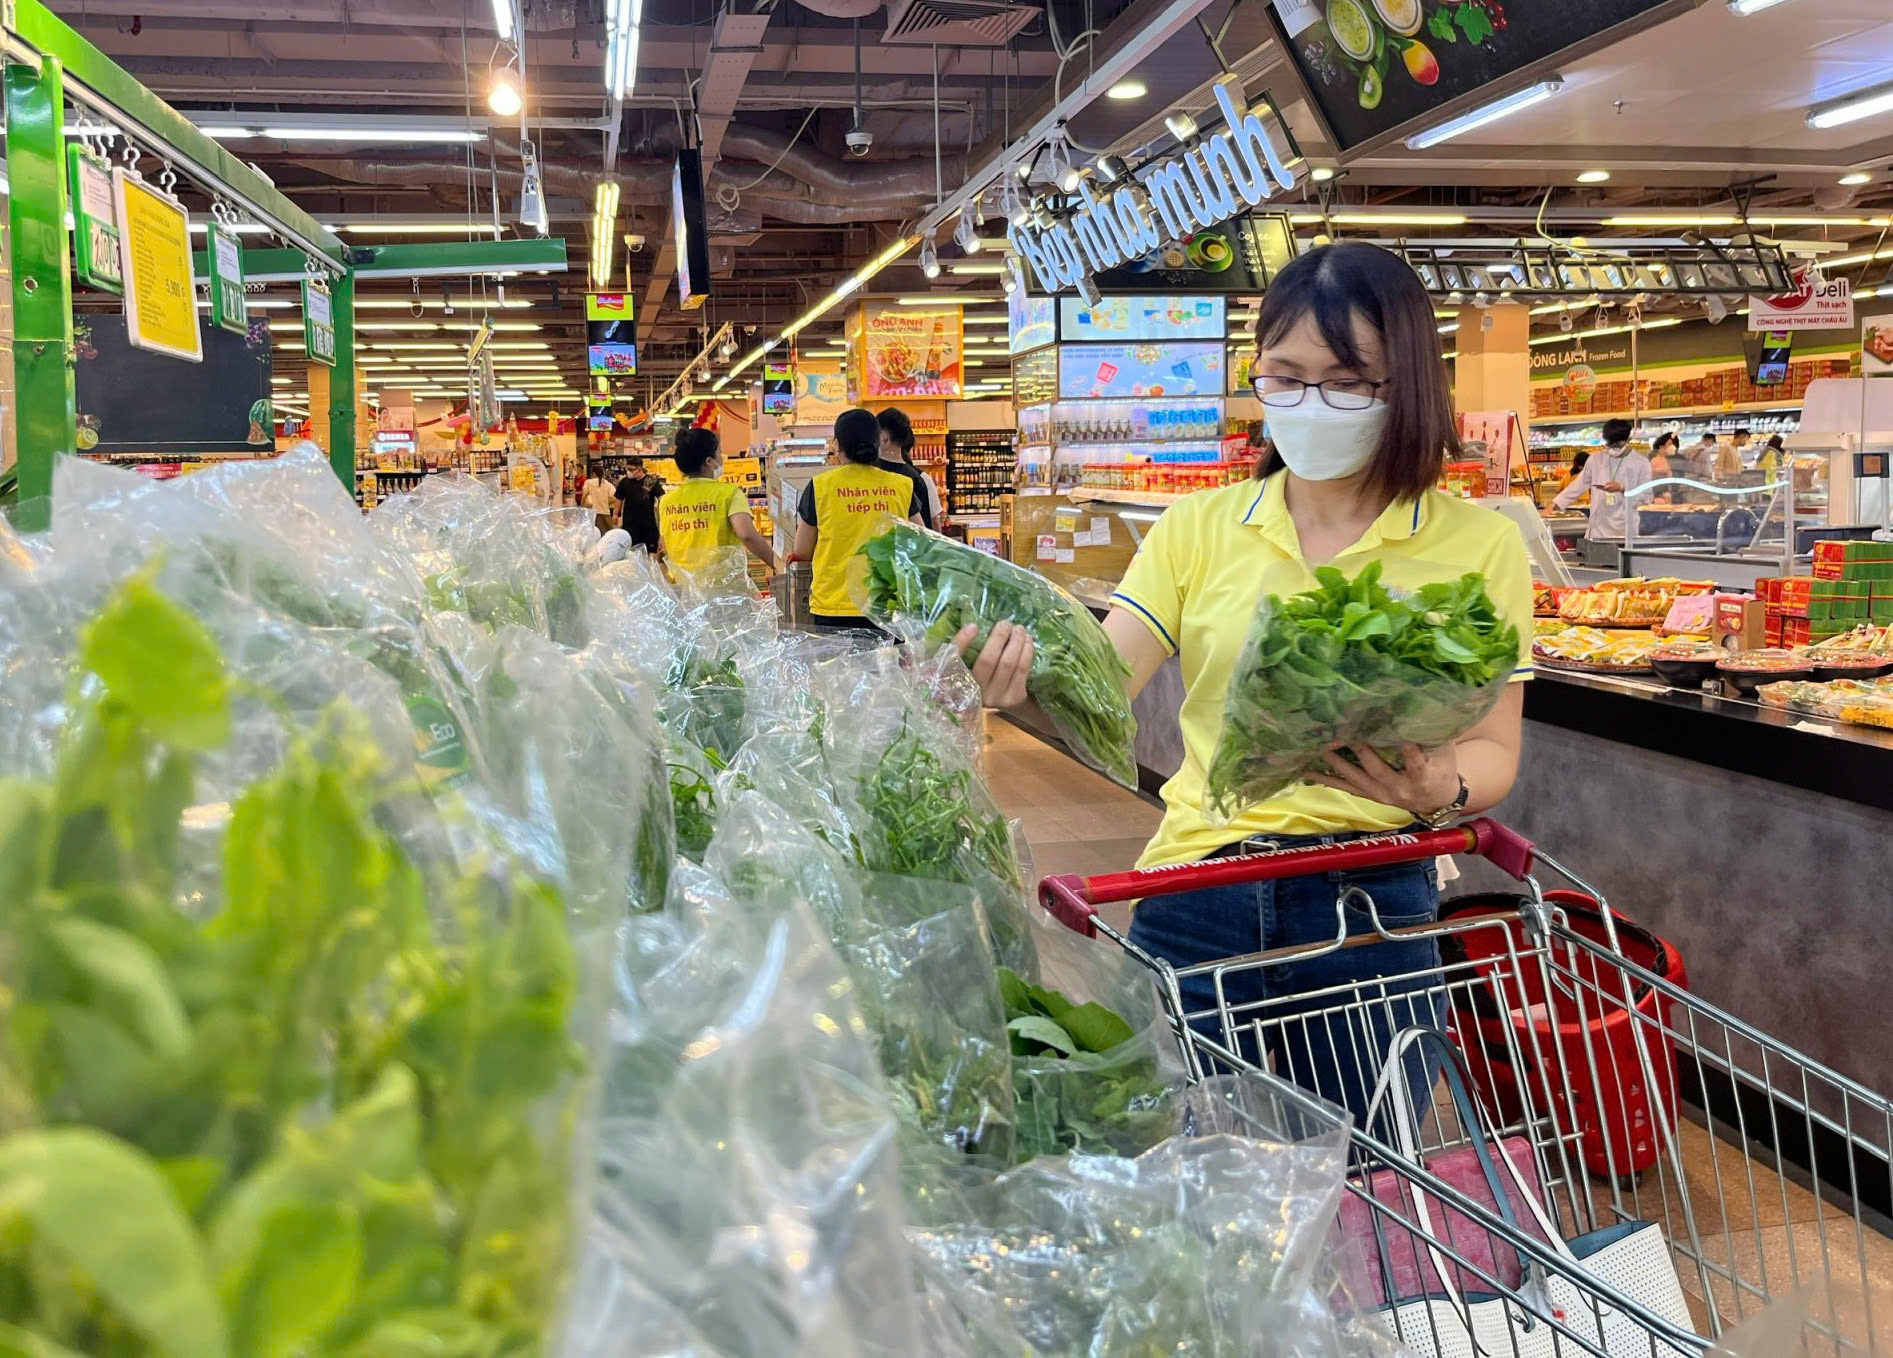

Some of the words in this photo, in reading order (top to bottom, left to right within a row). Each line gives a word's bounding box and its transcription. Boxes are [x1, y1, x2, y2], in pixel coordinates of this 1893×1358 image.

[1589, 353, 1609, 361] Frozen
[1610, 348, 1626, 358] Food
[837, 487, 869, 497] Nhân
[872, 486, 896, 496] viên
[665, 503, 689, 515] Nhân
[692, 501, 716, 513] viên
[847, 500, 871, 514] tiếp
[671, 519, 690, 532] tiếp
[693, 518, 709, 531] thị
